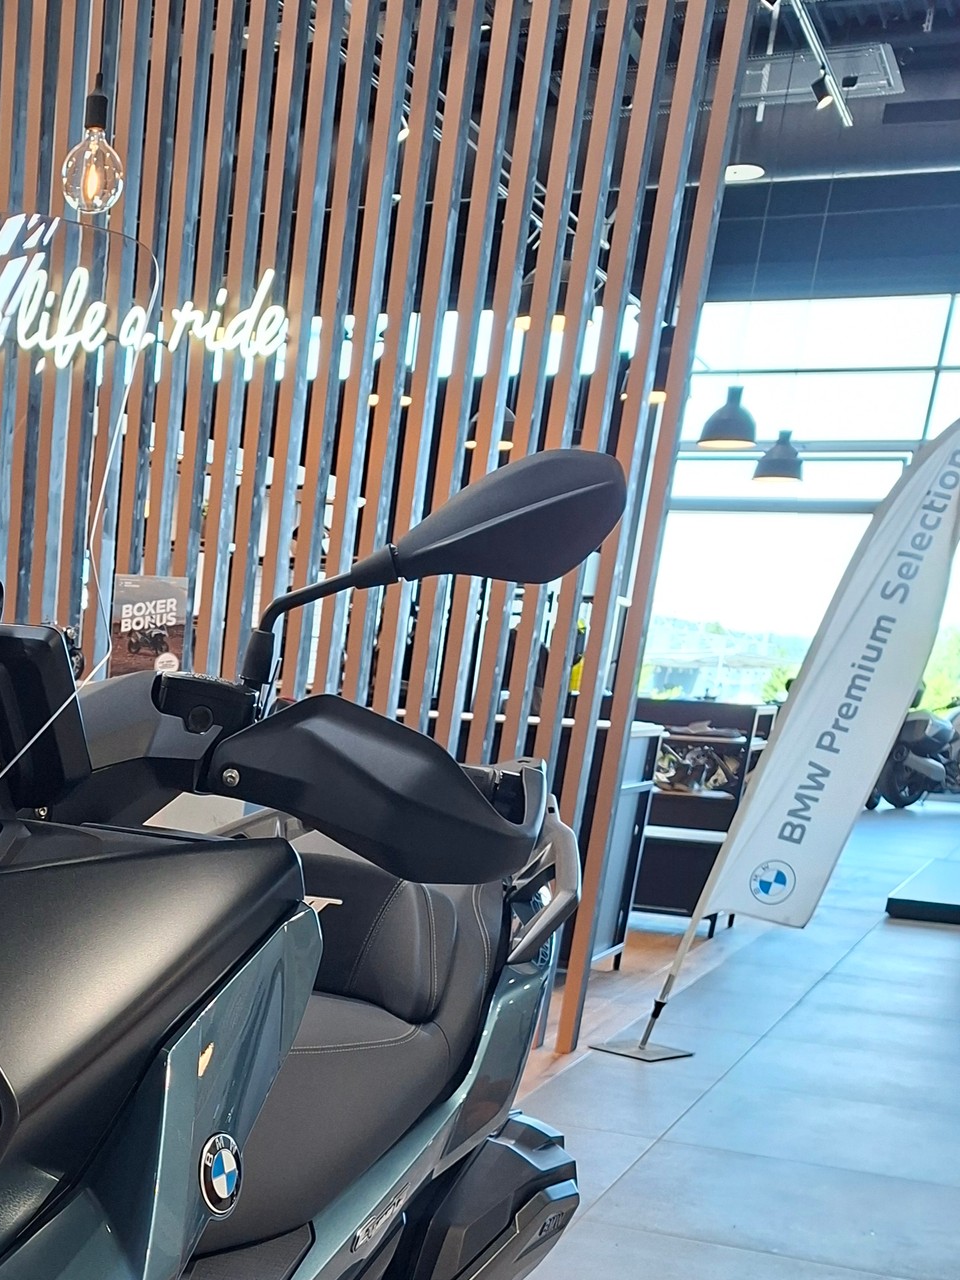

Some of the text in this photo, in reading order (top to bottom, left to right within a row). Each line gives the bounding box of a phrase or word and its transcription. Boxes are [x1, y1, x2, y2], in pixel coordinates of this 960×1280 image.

[16, 266, 107, 369] life
[119, 305, 156, 351] a
[167, 268, 289, 357] ride
[120, 612, 178, 633] BONUS
[121, 598, 178, 619] BOXER
[778, 761, 832, 846] BMW
[816, 612, 898, 755] Premium
[204, 1135, 238, 1168] BMW
